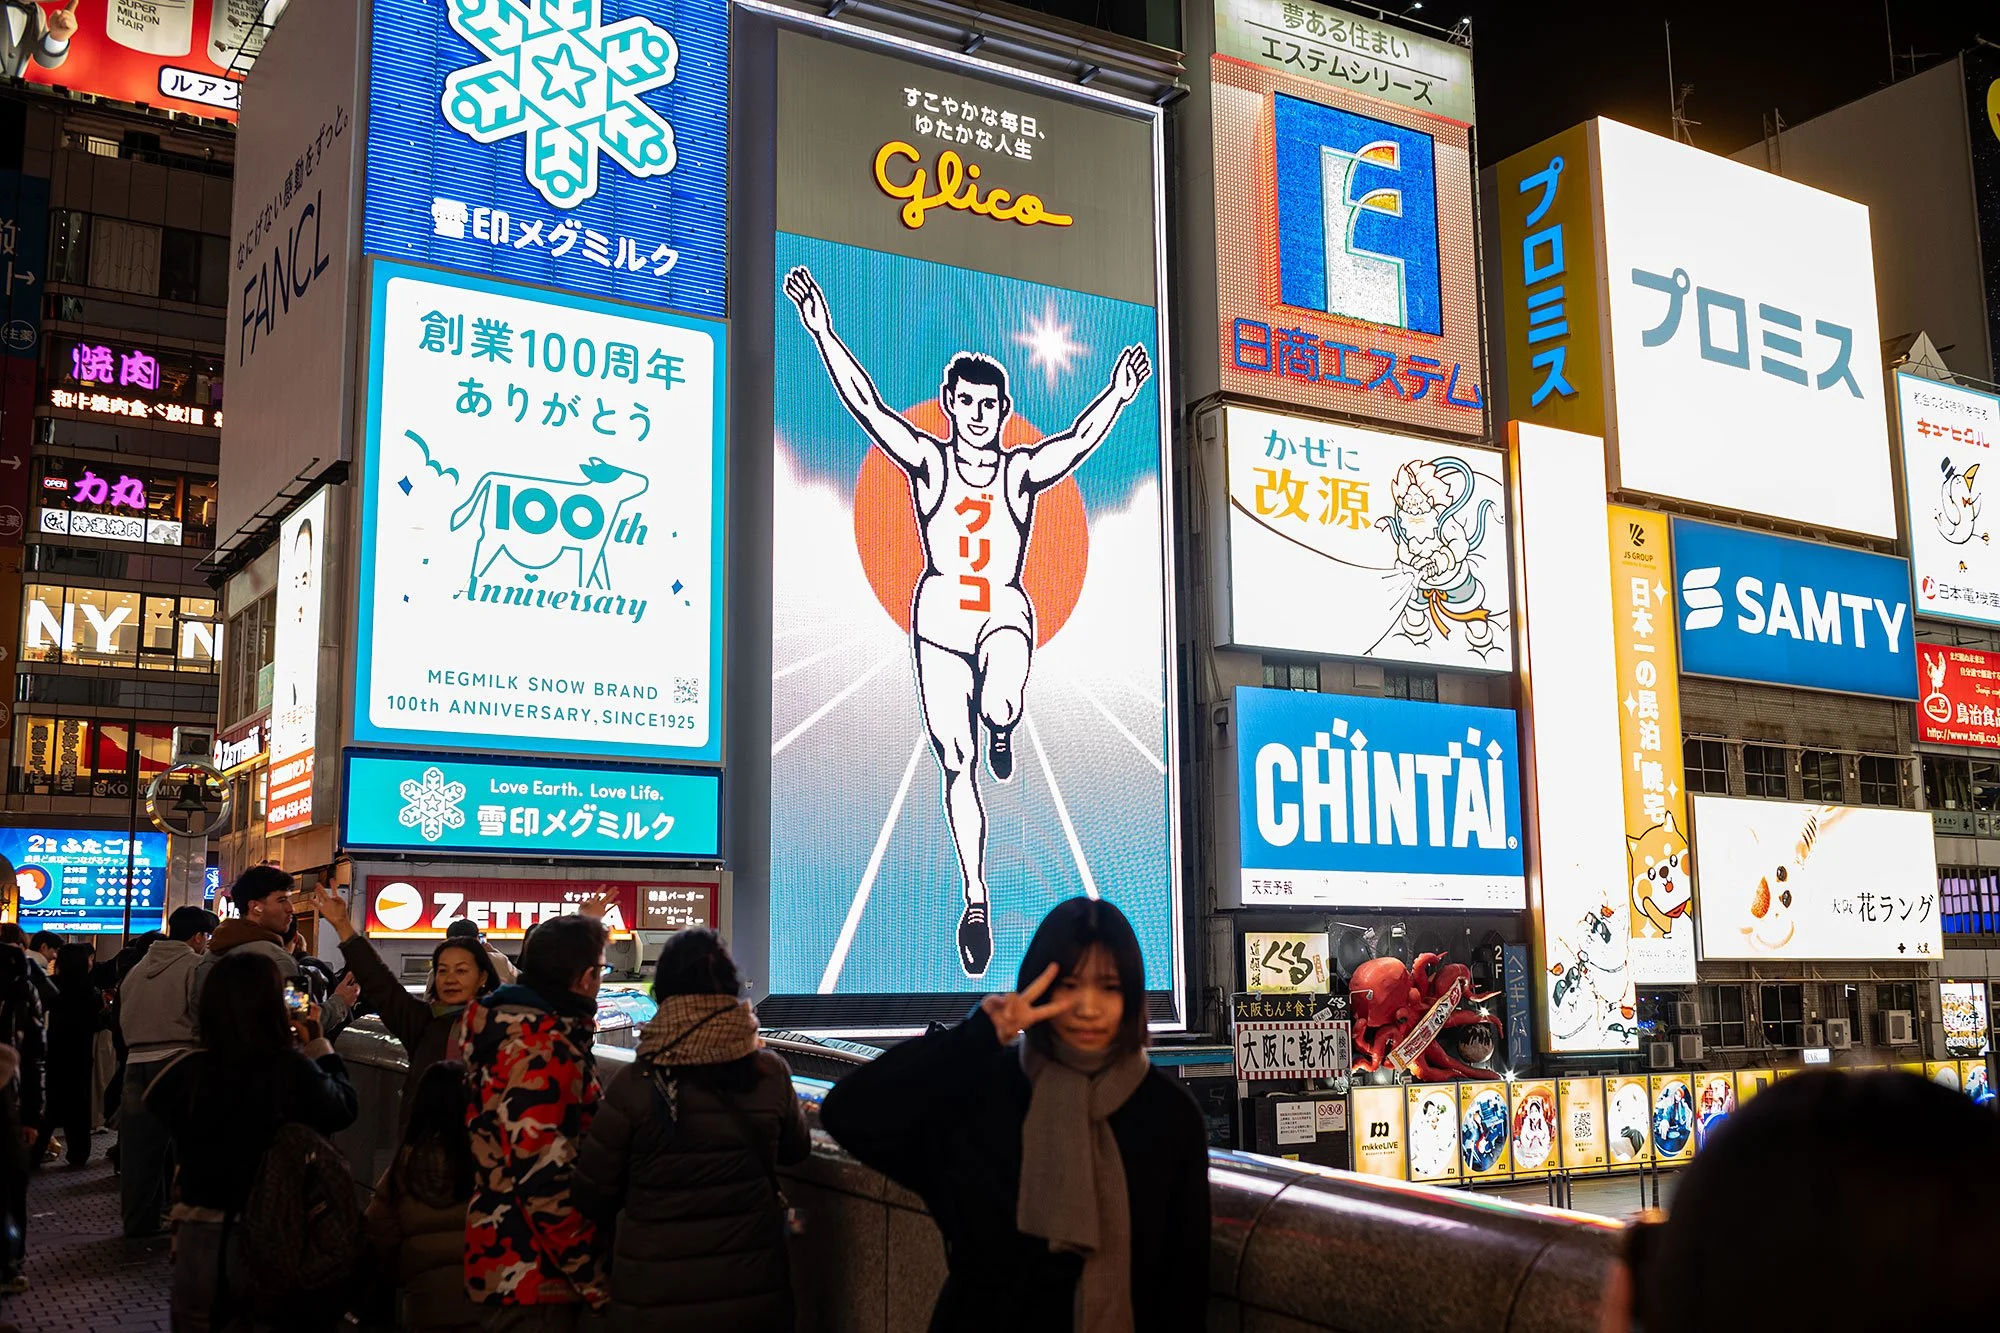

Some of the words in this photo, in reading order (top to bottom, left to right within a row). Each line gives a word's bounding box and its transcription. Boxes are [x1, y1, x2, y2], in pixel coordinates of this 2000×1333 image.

[116, 16, 144, 31] HAIR
[118, 8, 160, 25] MILLION
[1283, 3, 1409, 58] 夢ある住まい
[1262, 36, 1432, 105] エステムシリーズ
[903, 87, 1045, 139] すこやかな毎日、
[915, 114, 1033, 160] ゆたかな人生
[237, 104, 348, 270] なにげない感動をずっと。
[874, 140, 1074, 230] Glico
[430, 197, 679, 276] 雪印メグミルク
[240, 189, 330, 368] FANCL
[1519, 155, 1579, 408] プロミス
[419, 310, 685, 391] 創業100周年
[1631, 267, 1865, 400] プロミス
[72, 343, 160, 390] 焼肉
[1234, 317, 1484, 409] 日商エステム
[455, 377, 651, 442] ありがとう
[1264, 429, 1360, 472] かぜに
[44, 479, 67, 488] OPEN
[73, 471, 147, 510] 力丸
[1252, 467, 1372, 530] 改源
[954, 493, 994, 613] グリコ
[1632, 552, 1654, 562] GROUP
[452, 576, 648, 623] Anniversary
[1735, 576, 1907, 654] SAMTY
[387, 695, 440, 713] 100th
[427, 669, 519, 690] MEGMILK
[528, 677, 586, 695] SNOW
[594, 682, 659, 700] BRAND
[60, 719, 79, 792] お好み焼き
[490, 778, 528, 795] Love
[533, 780, 583, 798] Earth.
[590, 784, 627, 799] Love
[630, 785, 664, 801] Life.
[1255, 717, 1507, 850] CHINTAI
[477, 804, 675, 841] 雪印メグミルク
[1252, 880, 1293, 895] 天気予報
[1857, 892, 1934, 923] 花ラング
[666, 915, 705, 926] コーヒー
[1261, 940, 1313, 985] くくる
[1236, 1001, 1317, 1018] 大阪もんを食す
[1334, 1010, 1348, 1020] 2F
[1243, 1030, 1335, 1069] 大阪に乾杯
[1361, 1141, 1399, 1151] mikkeLIVE
